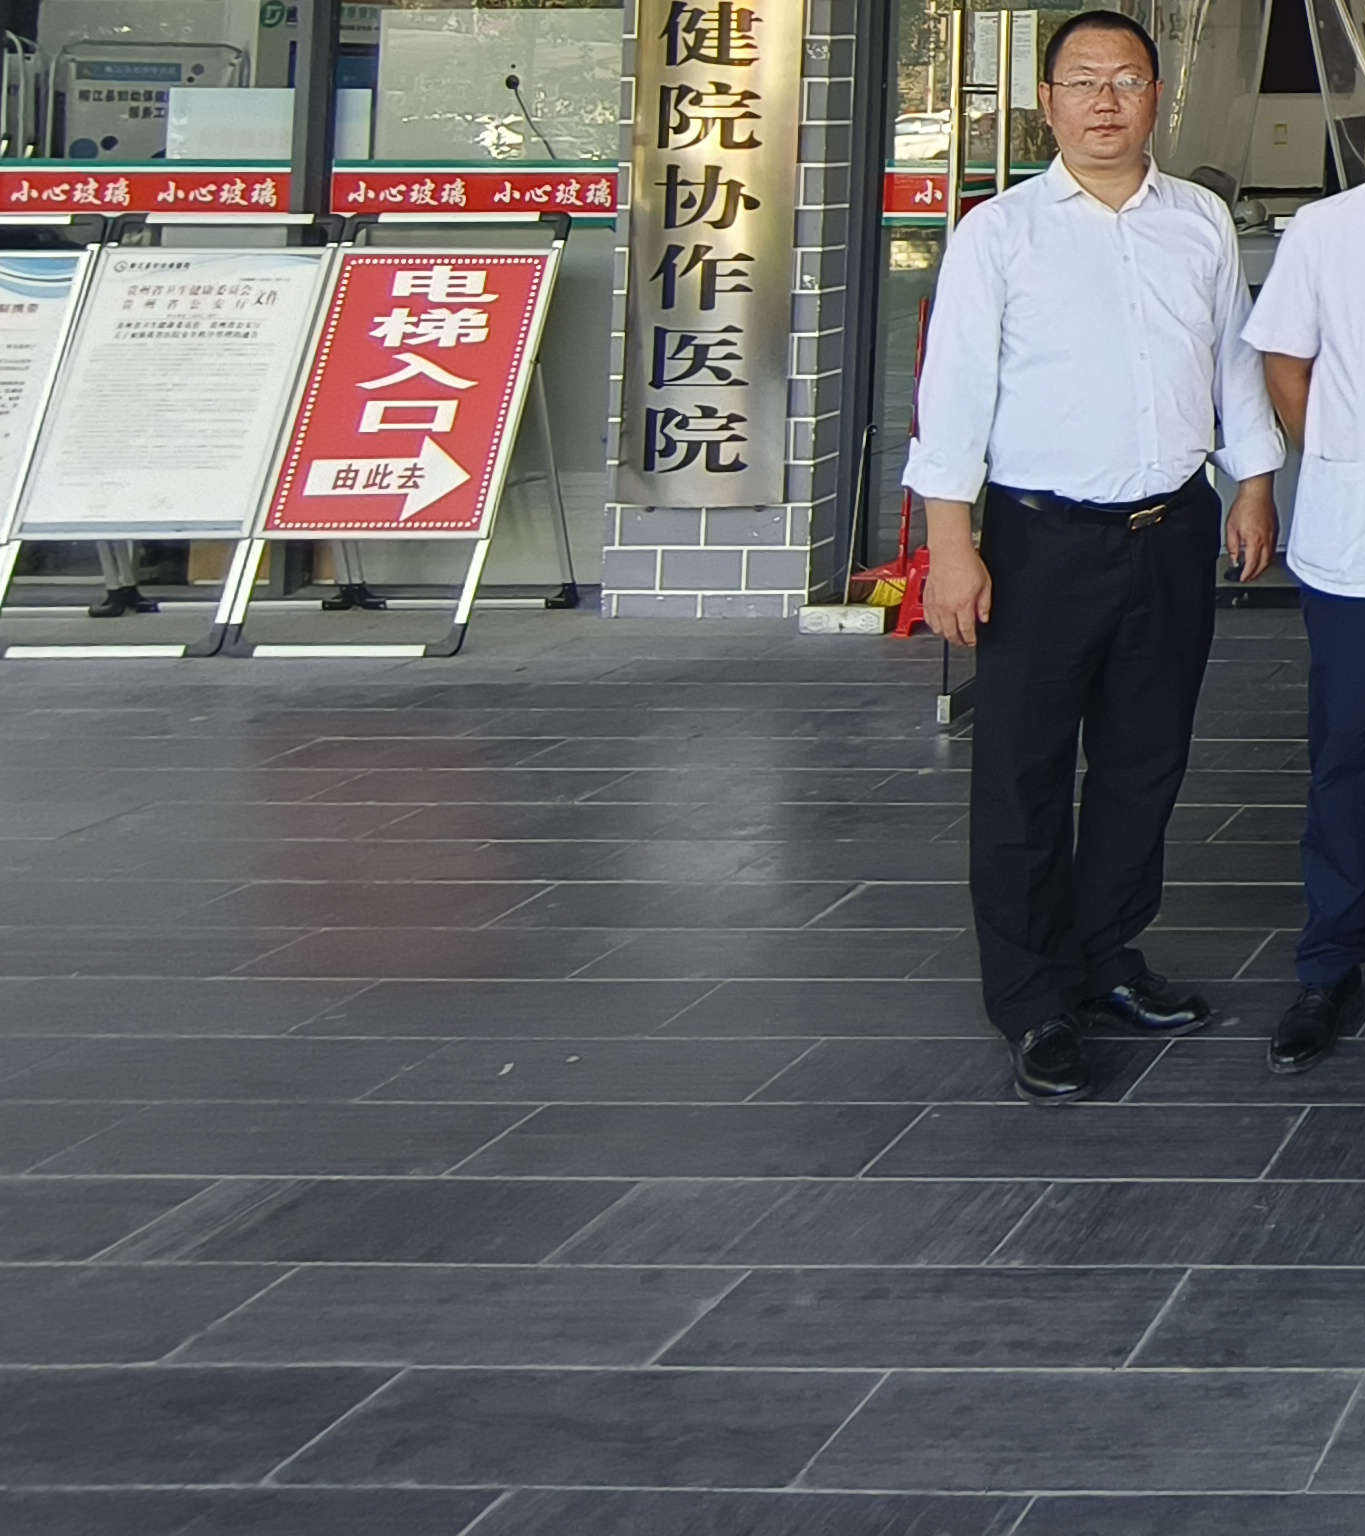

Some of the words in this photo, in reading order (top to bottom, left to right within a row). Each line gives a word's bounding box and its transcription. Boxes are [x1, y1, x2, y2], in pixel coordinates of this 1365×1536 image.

[10, 176, 132, 208] 小心玻璃
[156, 176, 279, 208] 小心玻璃
[347, 177, 468, 208] 小心玻璃
[493, 177, 613, 208] 小心玻璃
[355, 266, 499, 435] 电梯入口
[331, 462, 426, 492] 由此去
